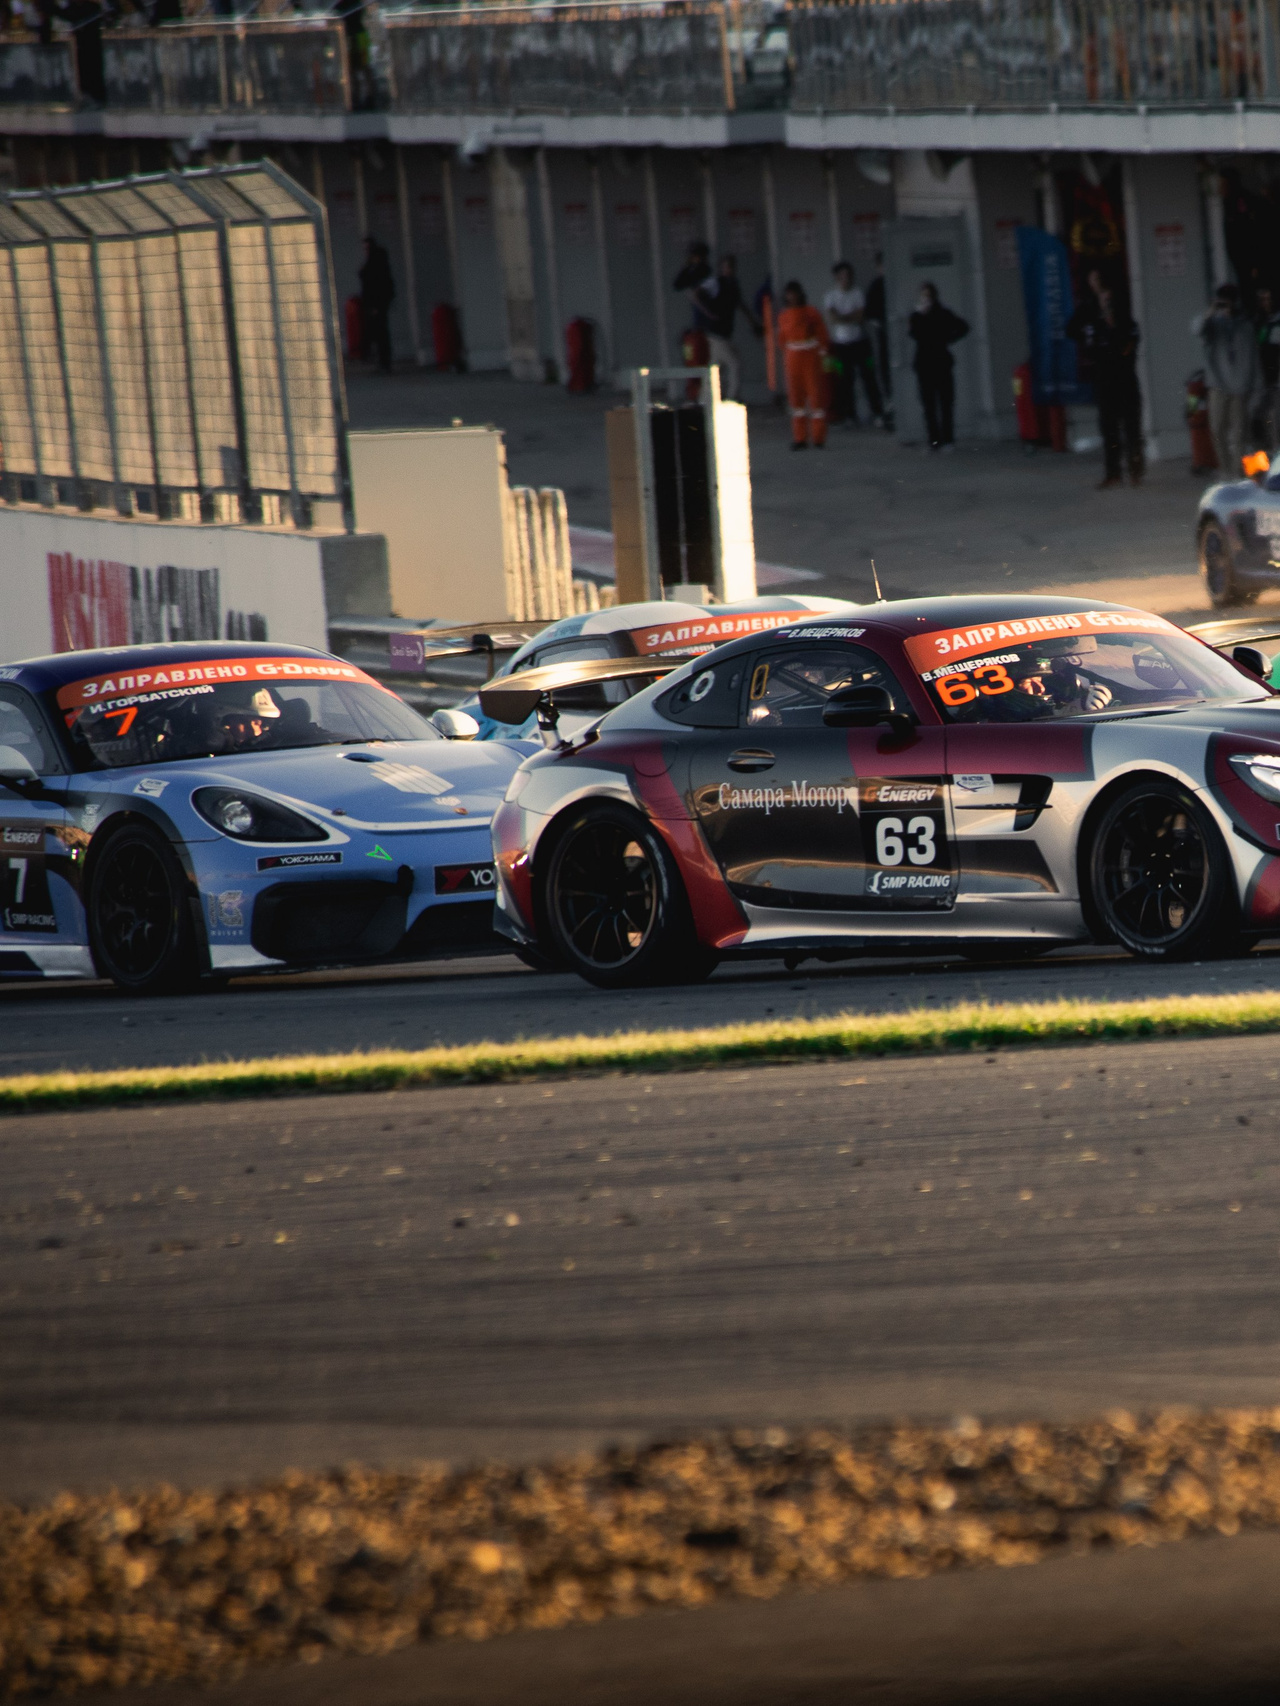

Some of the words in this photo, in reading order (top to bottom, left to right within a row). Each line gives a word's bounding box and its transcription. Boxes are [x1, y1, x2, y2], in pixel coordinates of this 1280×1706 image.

[646, 617, 791, 647] ЗАПРАВЛЕНО
[935, 616, 1082, 654] ЗАПРАВЛЕНО
[82, 664, 247, 698] ЗАПРАВЛЕНО
[921, 653, 1021, 682] В.МЕЩЕРЯКОВ
[89, 684, 215, 714] И.ГОРБАТСКИЙ
[935, 664, 1014, 706] 63
[104, 706, 139, 736] 7
[718, 780, 848, 815] Самара-Мотор
[876, 816, 937, 866] 63
[279, 854, 336, 865] YOKOHAMA
[9, 858, 27, 903] 7
[881, 876, 907, 889] SMP
[907, 875, 951, 888] RACING
